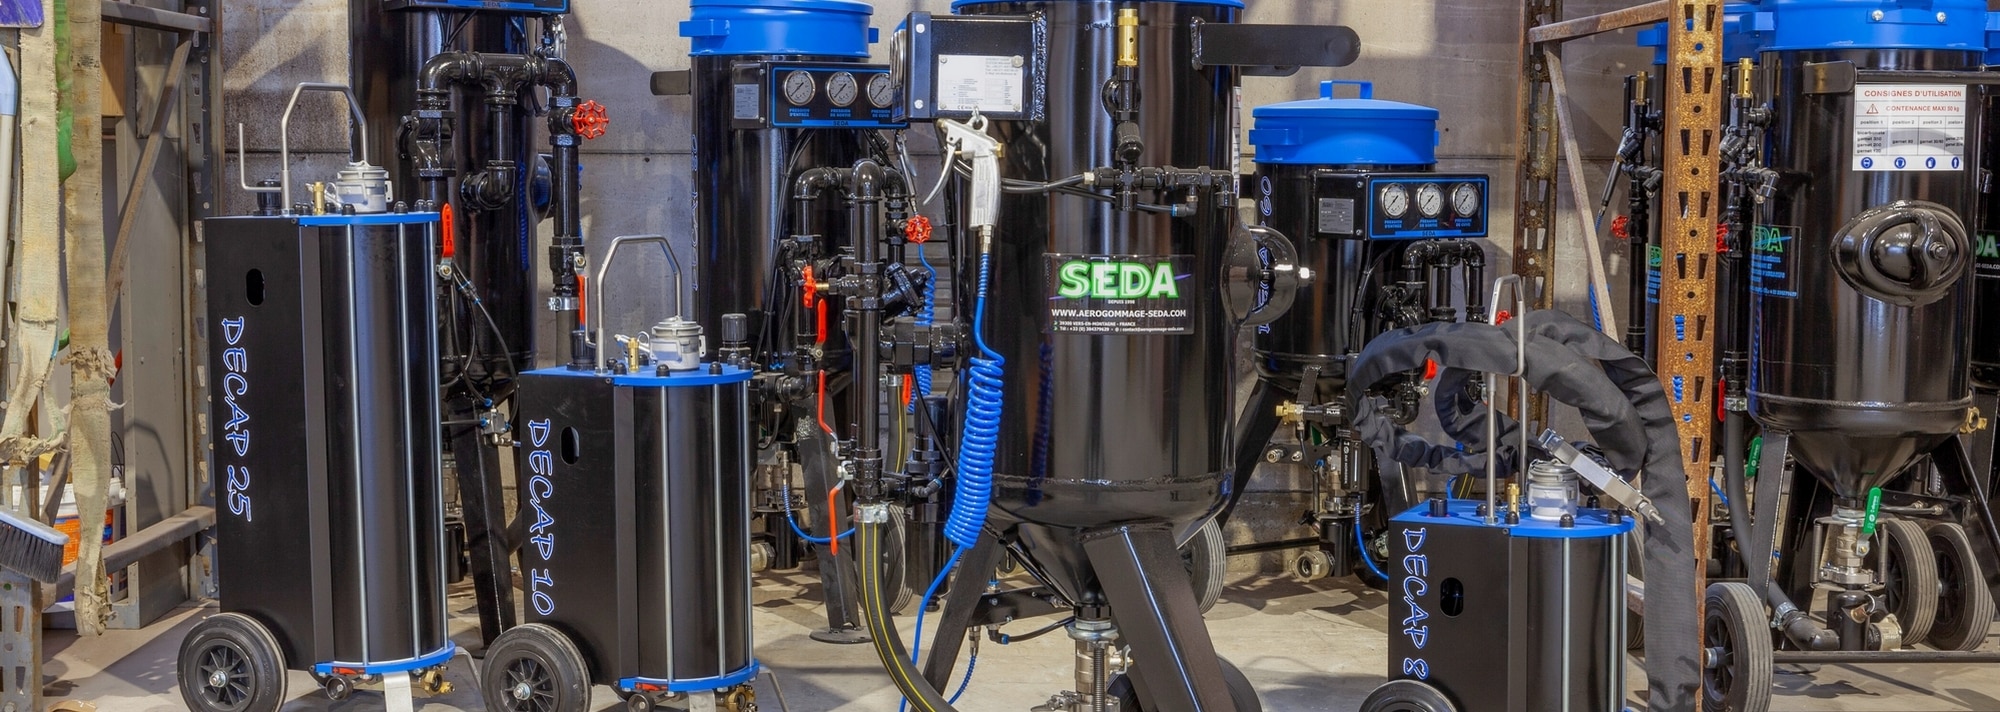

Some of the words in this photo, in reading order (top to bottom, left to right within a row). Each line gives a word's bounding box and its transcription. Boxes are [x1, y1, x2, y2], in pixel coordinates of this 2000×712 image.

[1058, 260, 1179, 299] SEDA
[1051, 309, 1186, 317] WWW.AEROGOMMAGE-SEDA.COM
[221, 316, 249, 456] DECAP
[227, 465, 251, 522] 25
[528, 418, 554, 560] DECAP
[531, 568, 554, 615] 10
[1403, 527, 1429, 649] DECAP
[1403, 657, 1429, 680] 8
